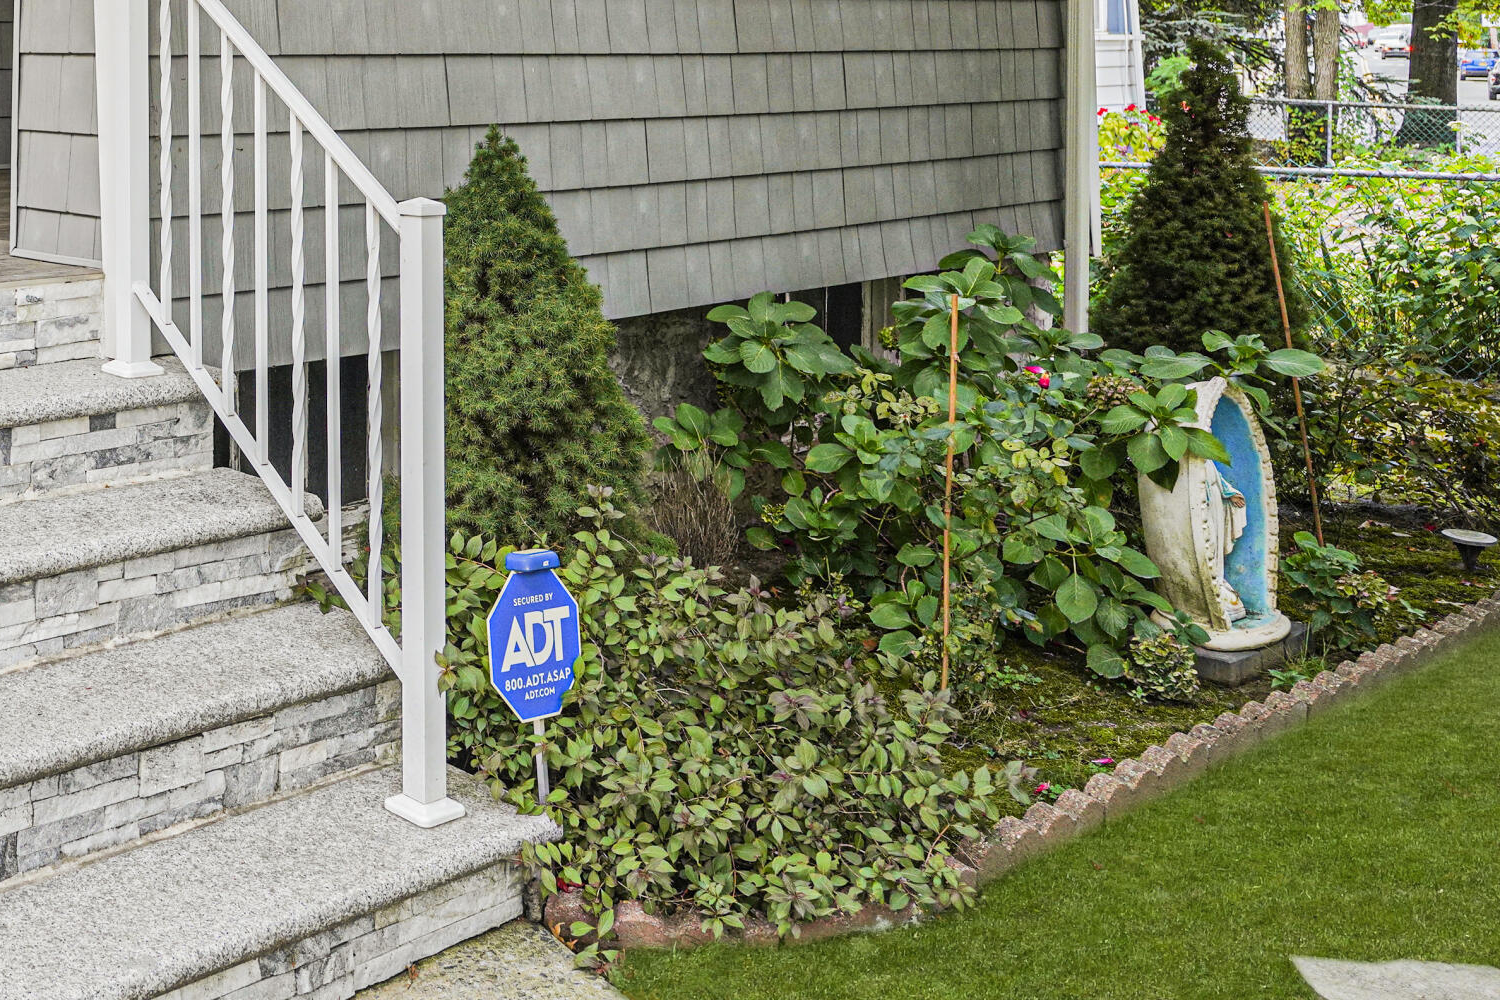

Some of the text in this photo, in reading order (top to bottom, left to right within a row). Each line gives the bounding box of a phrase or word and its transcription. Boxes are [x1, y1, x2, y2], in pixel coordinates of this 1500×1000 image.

[513, 592, 554, 607] SECURED BY
[501, 605, 570, 673] ADT
[504, 667, 571, 692] 800.ADT.ASAP
[524, 686, 556, 701] ADT.COM
